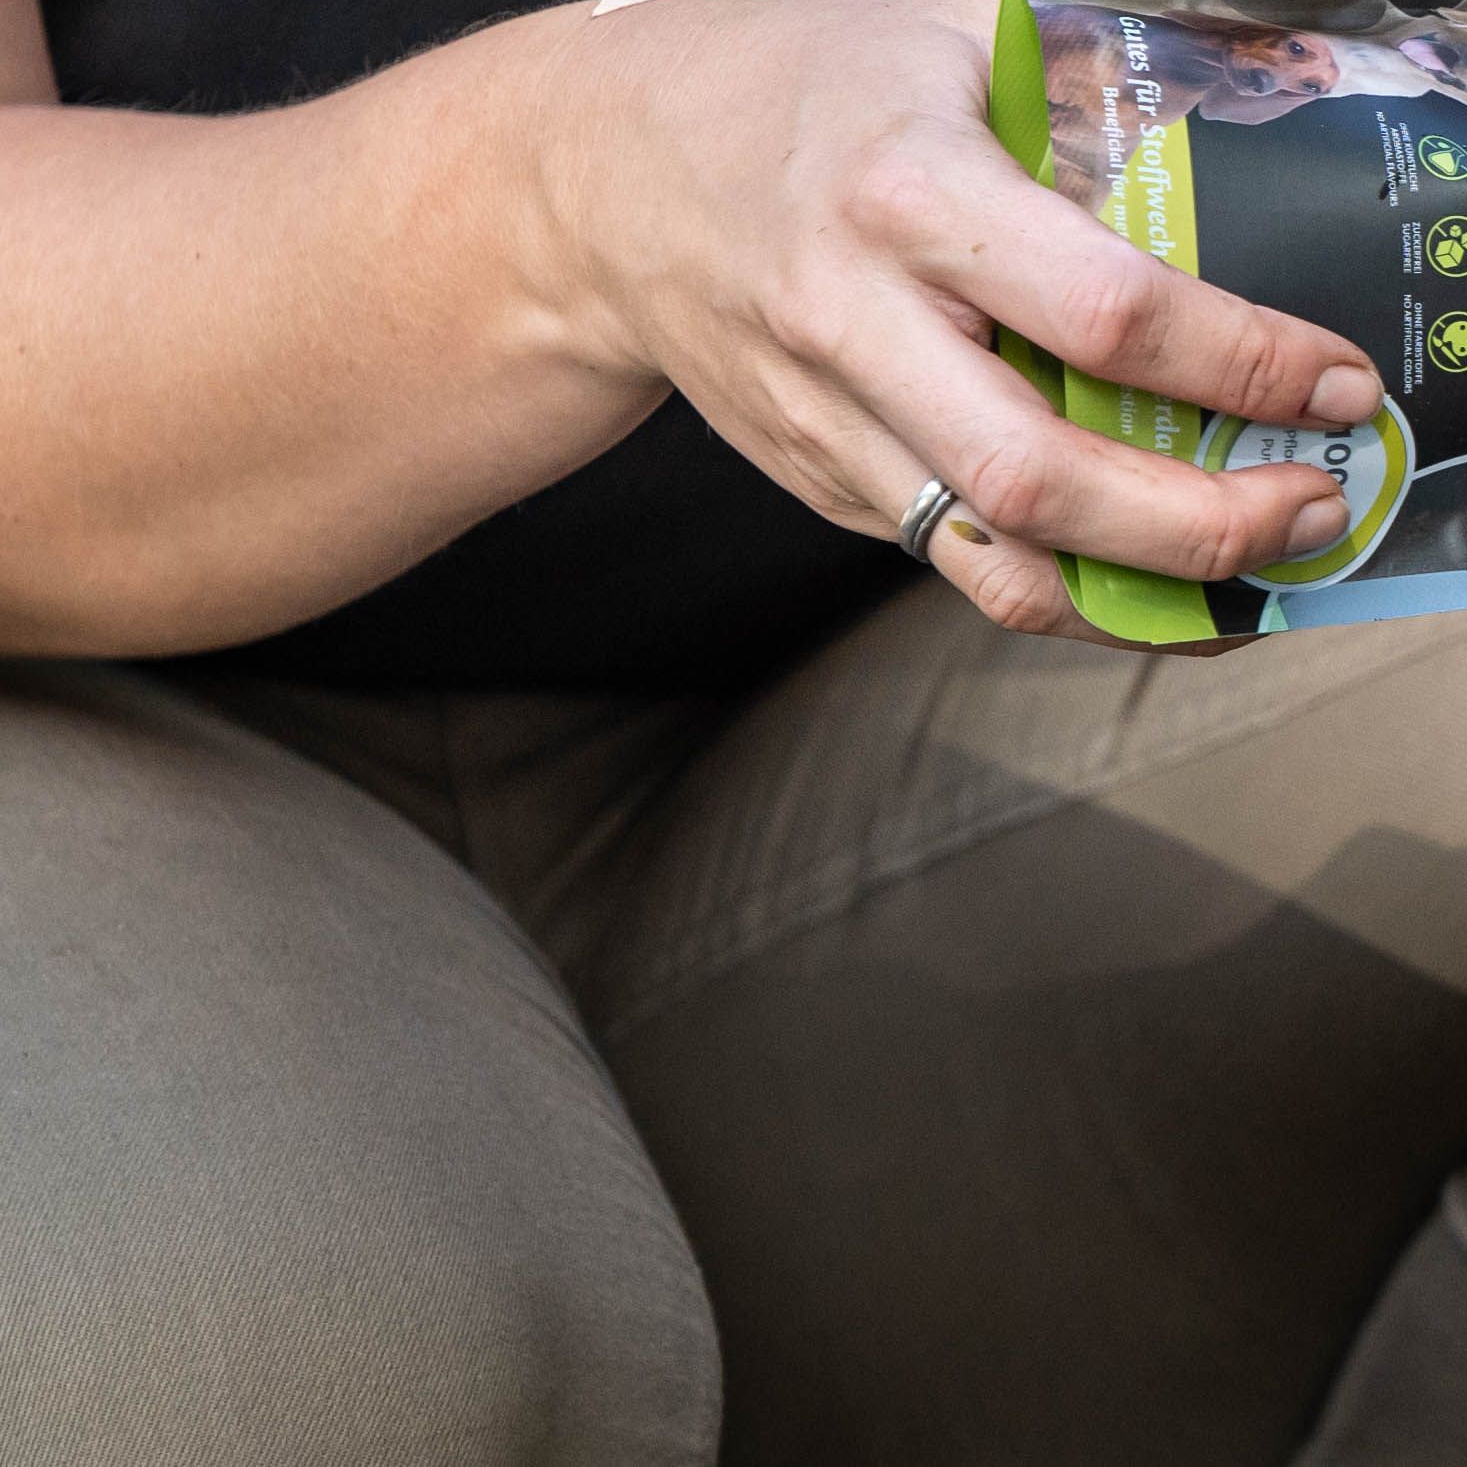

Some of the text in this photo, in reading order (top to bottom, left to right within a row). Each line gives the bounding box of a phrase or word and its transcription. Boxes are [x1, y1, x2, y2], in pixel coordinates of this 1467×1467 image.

[1101, 86, 1127, 168] Beneficial
[1117, 16, 1175, 257] Gutes für Stoffwech
[1378, 123, 1393, 161] ARTIFICIAL
[1106, 173, 1130, 199] for
[1385, 162, 1398, 207] FLAVOURS
[1401, 223, 1411, 274] SUGARFREE
[1411, 222, 1421, 274] ZUCKERFREI
[1402, 294, 1412, 394] NO ARTIFICIAL COLORS
[1413, 302, 1423, 385] OHNE FARBSTOFFE
[1260, 438, 1274, 462] Pur
